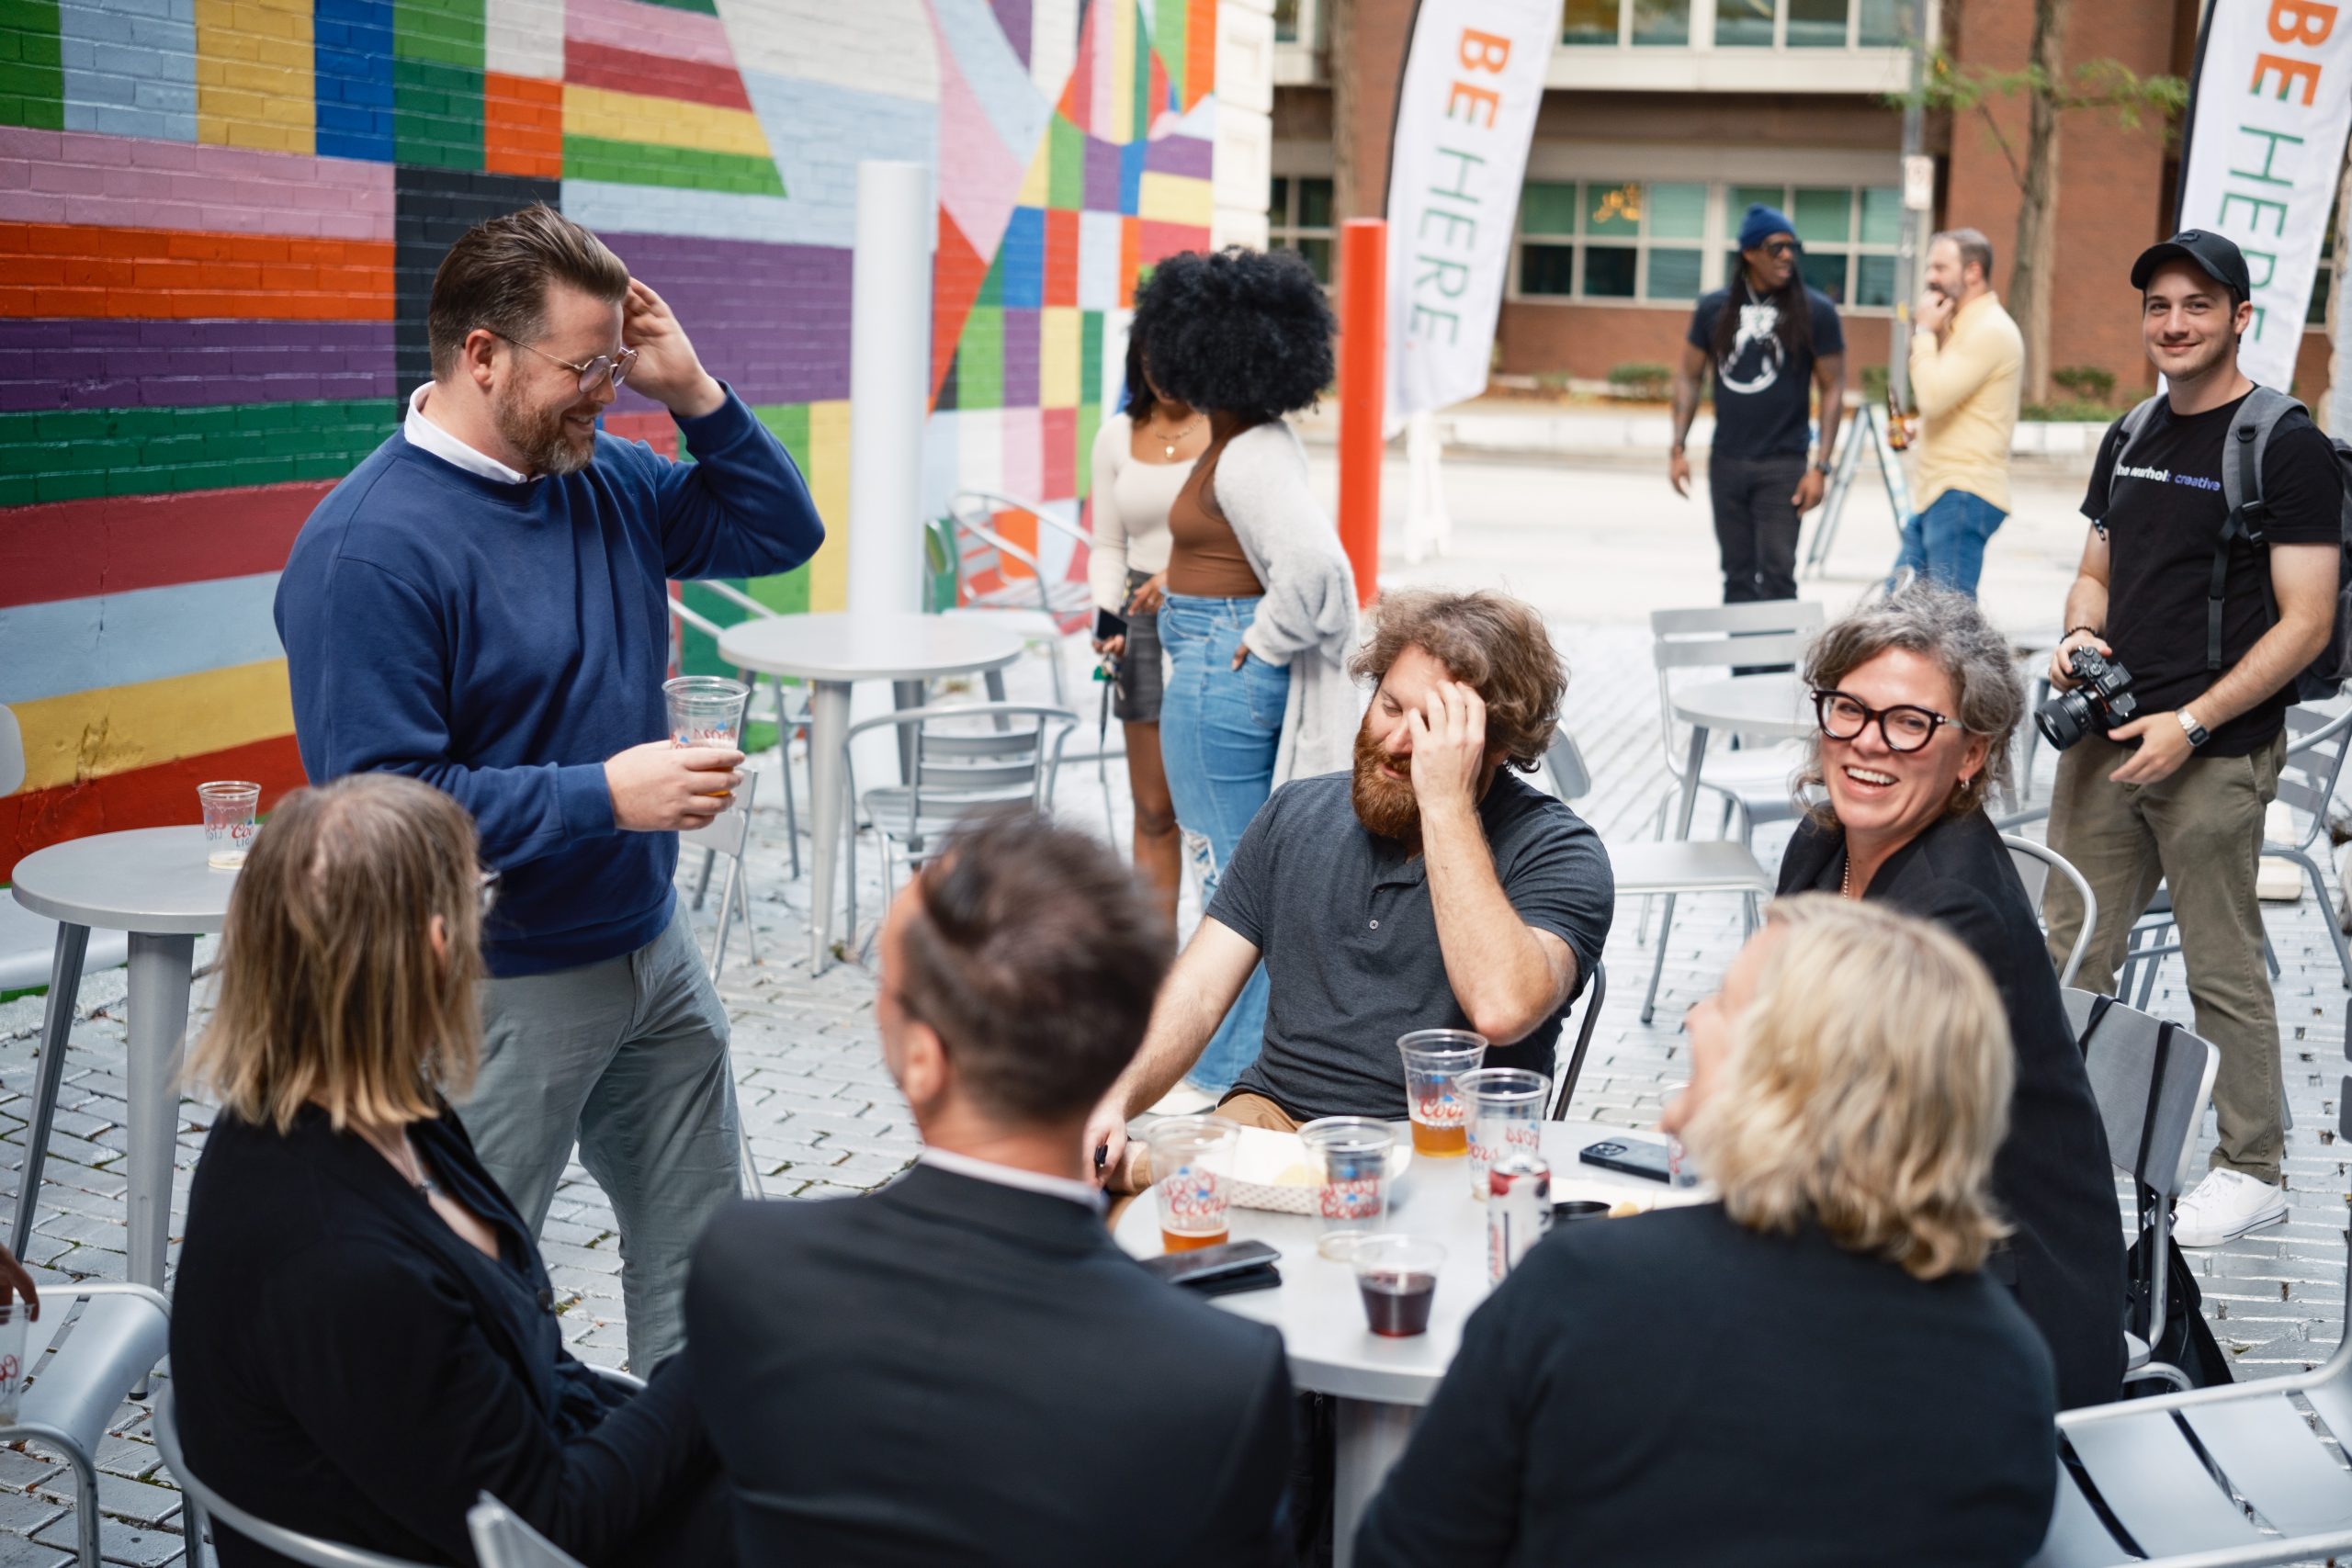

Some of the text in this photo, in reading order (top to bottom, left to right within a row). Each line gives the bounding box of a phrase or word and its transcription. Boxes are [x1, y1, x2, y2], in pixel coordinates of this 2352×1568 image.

[1446, 28, 1512, 130] BE
[2248, 0, 2339, 108] BE
[2174, 472, 2222, 491] creative
